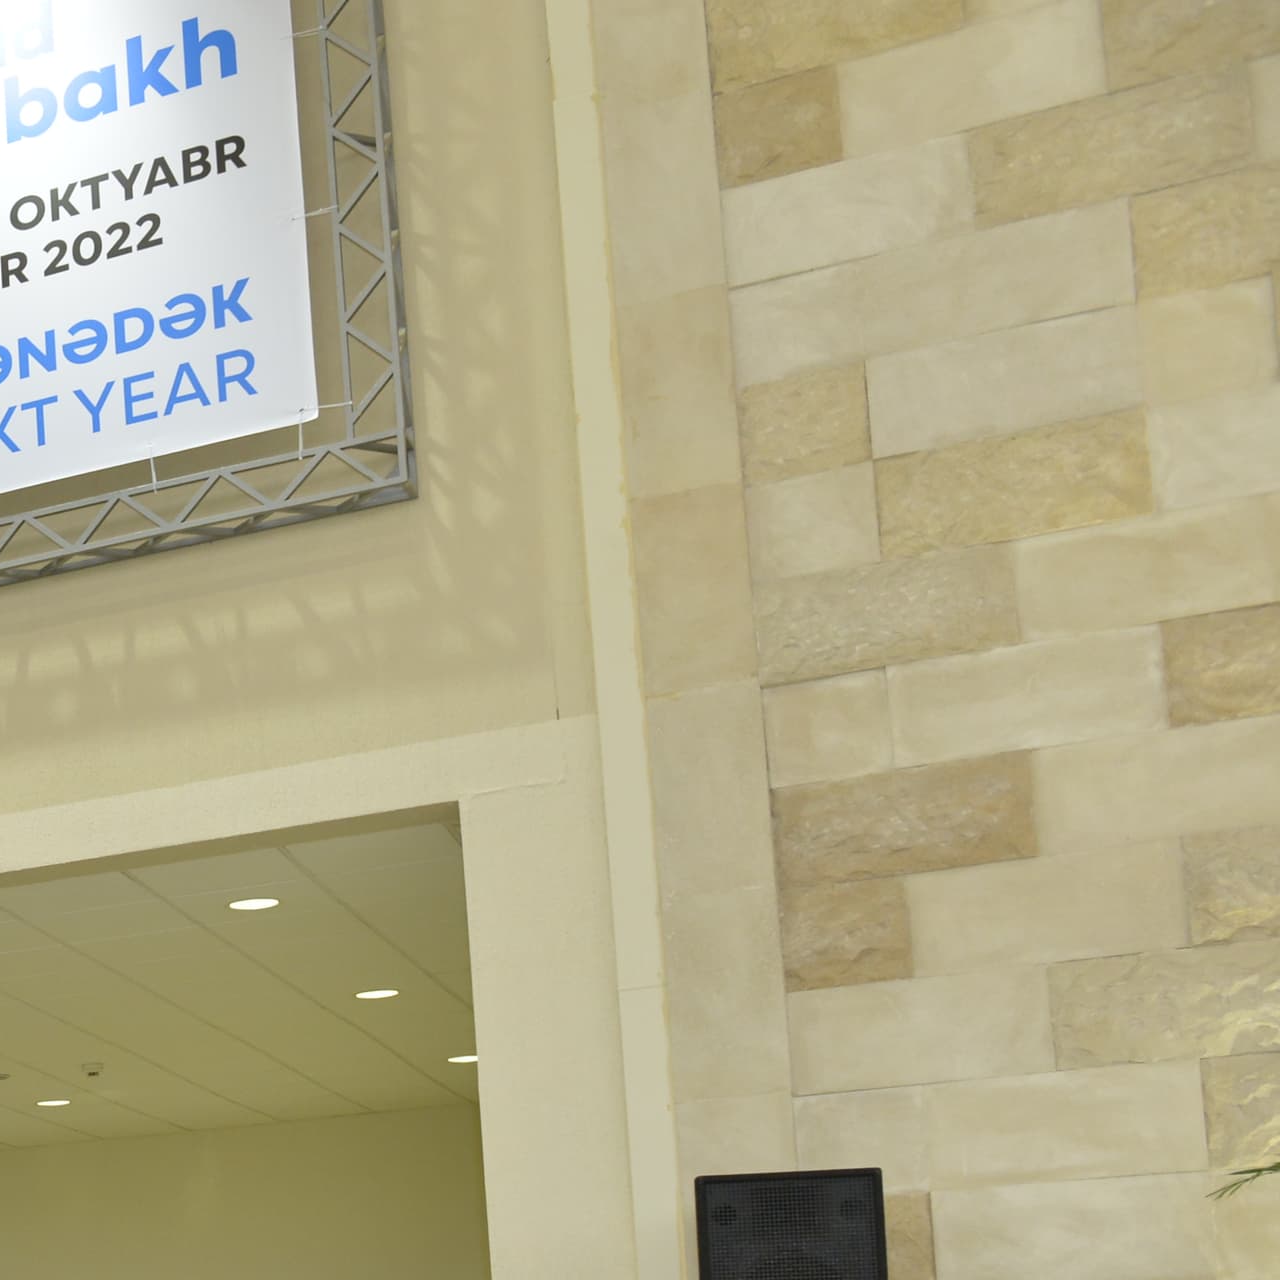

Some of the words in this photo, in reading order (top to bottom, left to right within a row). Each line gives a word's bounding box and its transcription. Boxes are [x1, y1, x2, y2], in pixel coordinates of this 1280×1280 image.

[9, 134, 248, 232] OKTYABR
[42, 212, 164, 276] 2022
[73, 348, 258, 434] YEAR
